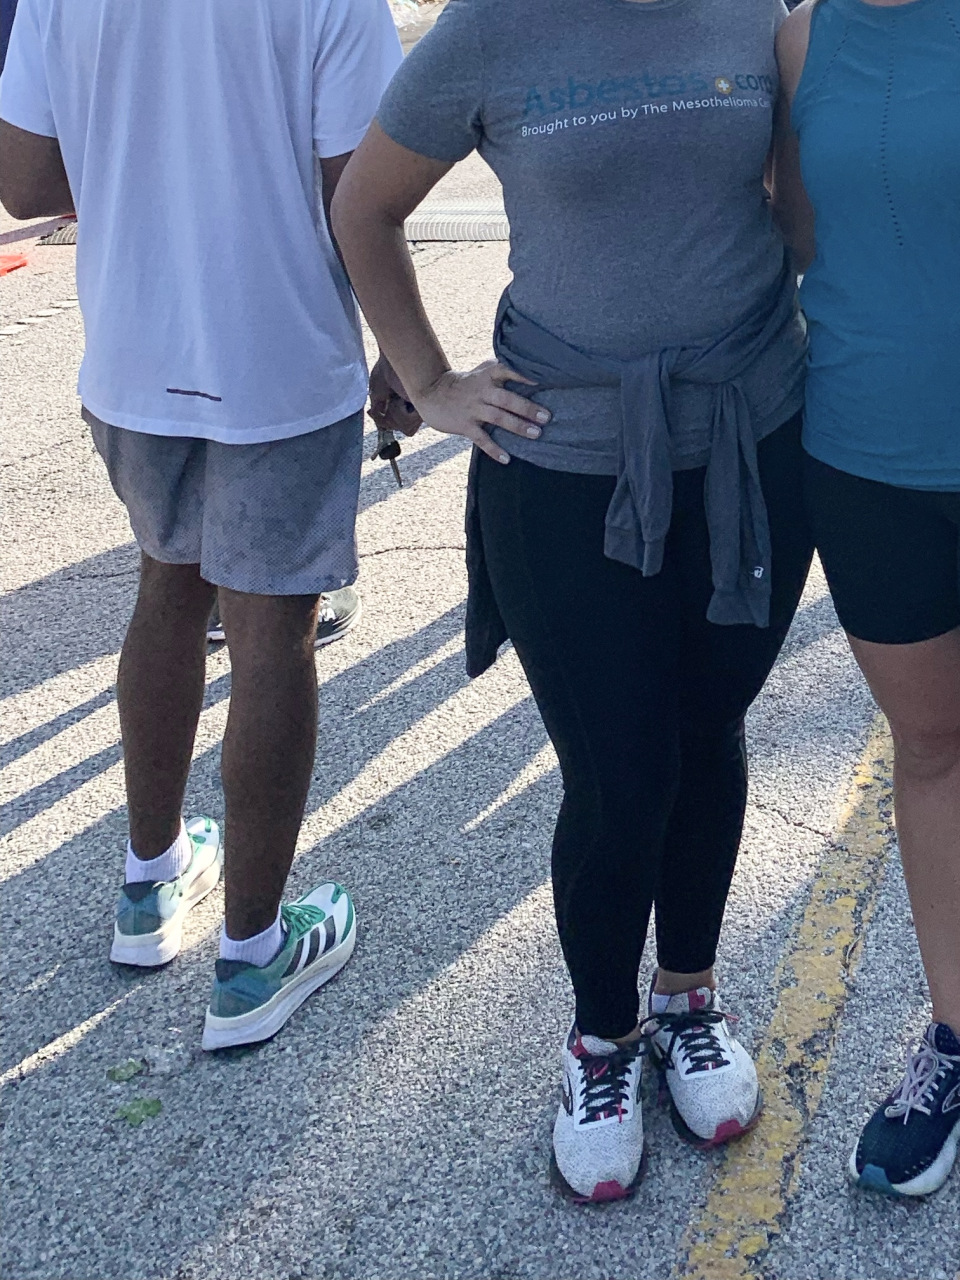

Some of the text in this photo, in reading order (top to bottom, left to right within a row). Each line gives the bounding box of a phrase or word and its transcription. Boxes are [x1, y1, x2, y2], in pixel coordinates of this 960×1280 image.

[521, 118, 569, 137] Brought
[572, 116, 587, 126] to
[590, 111, 617, 126] you
[620, 106, 639, 119] by
[641, 103, 668, 115] The
[672, 96, 758, 112] Mesothelioma
